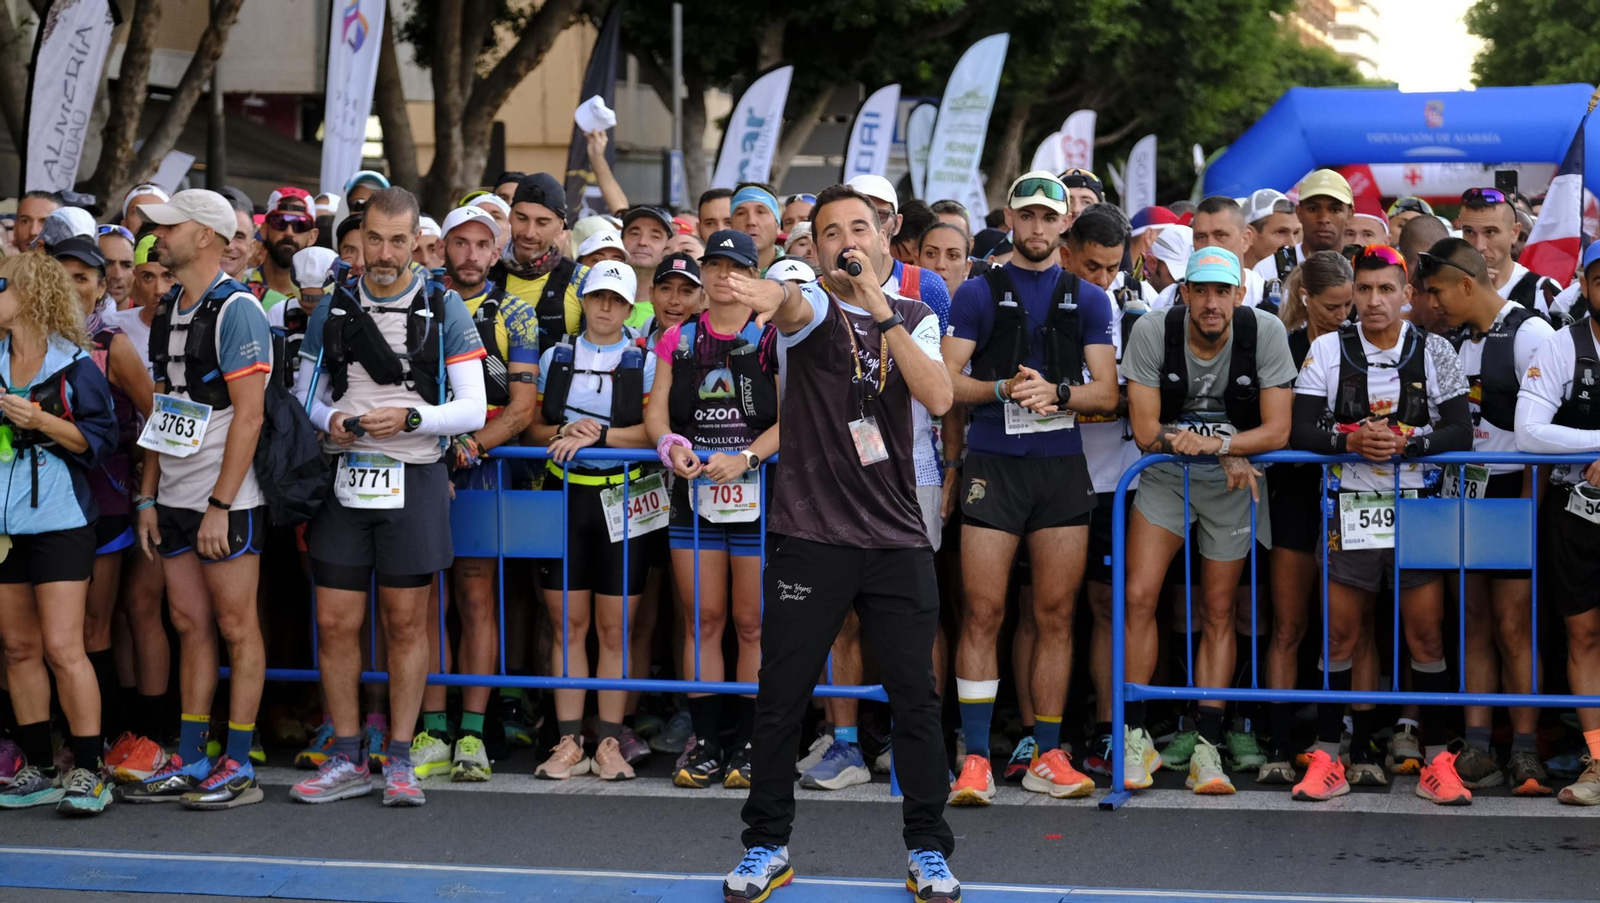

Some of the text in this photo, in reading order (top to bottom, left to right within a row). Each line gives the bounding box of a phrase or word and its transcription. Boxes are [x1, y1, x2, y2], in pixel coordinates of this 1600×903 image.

[55, 109, 88, 190] CIUDAD
[1435, 132, 1450, 143] DE
[1453, 131, 1502, 144] ALMERÍA
[743, 376, 757, 417] AONIJIE
[158, 412, 196, 439] 3763
[348, 467, 390, 489] 3771
[709, 484, 743, 504] 703
